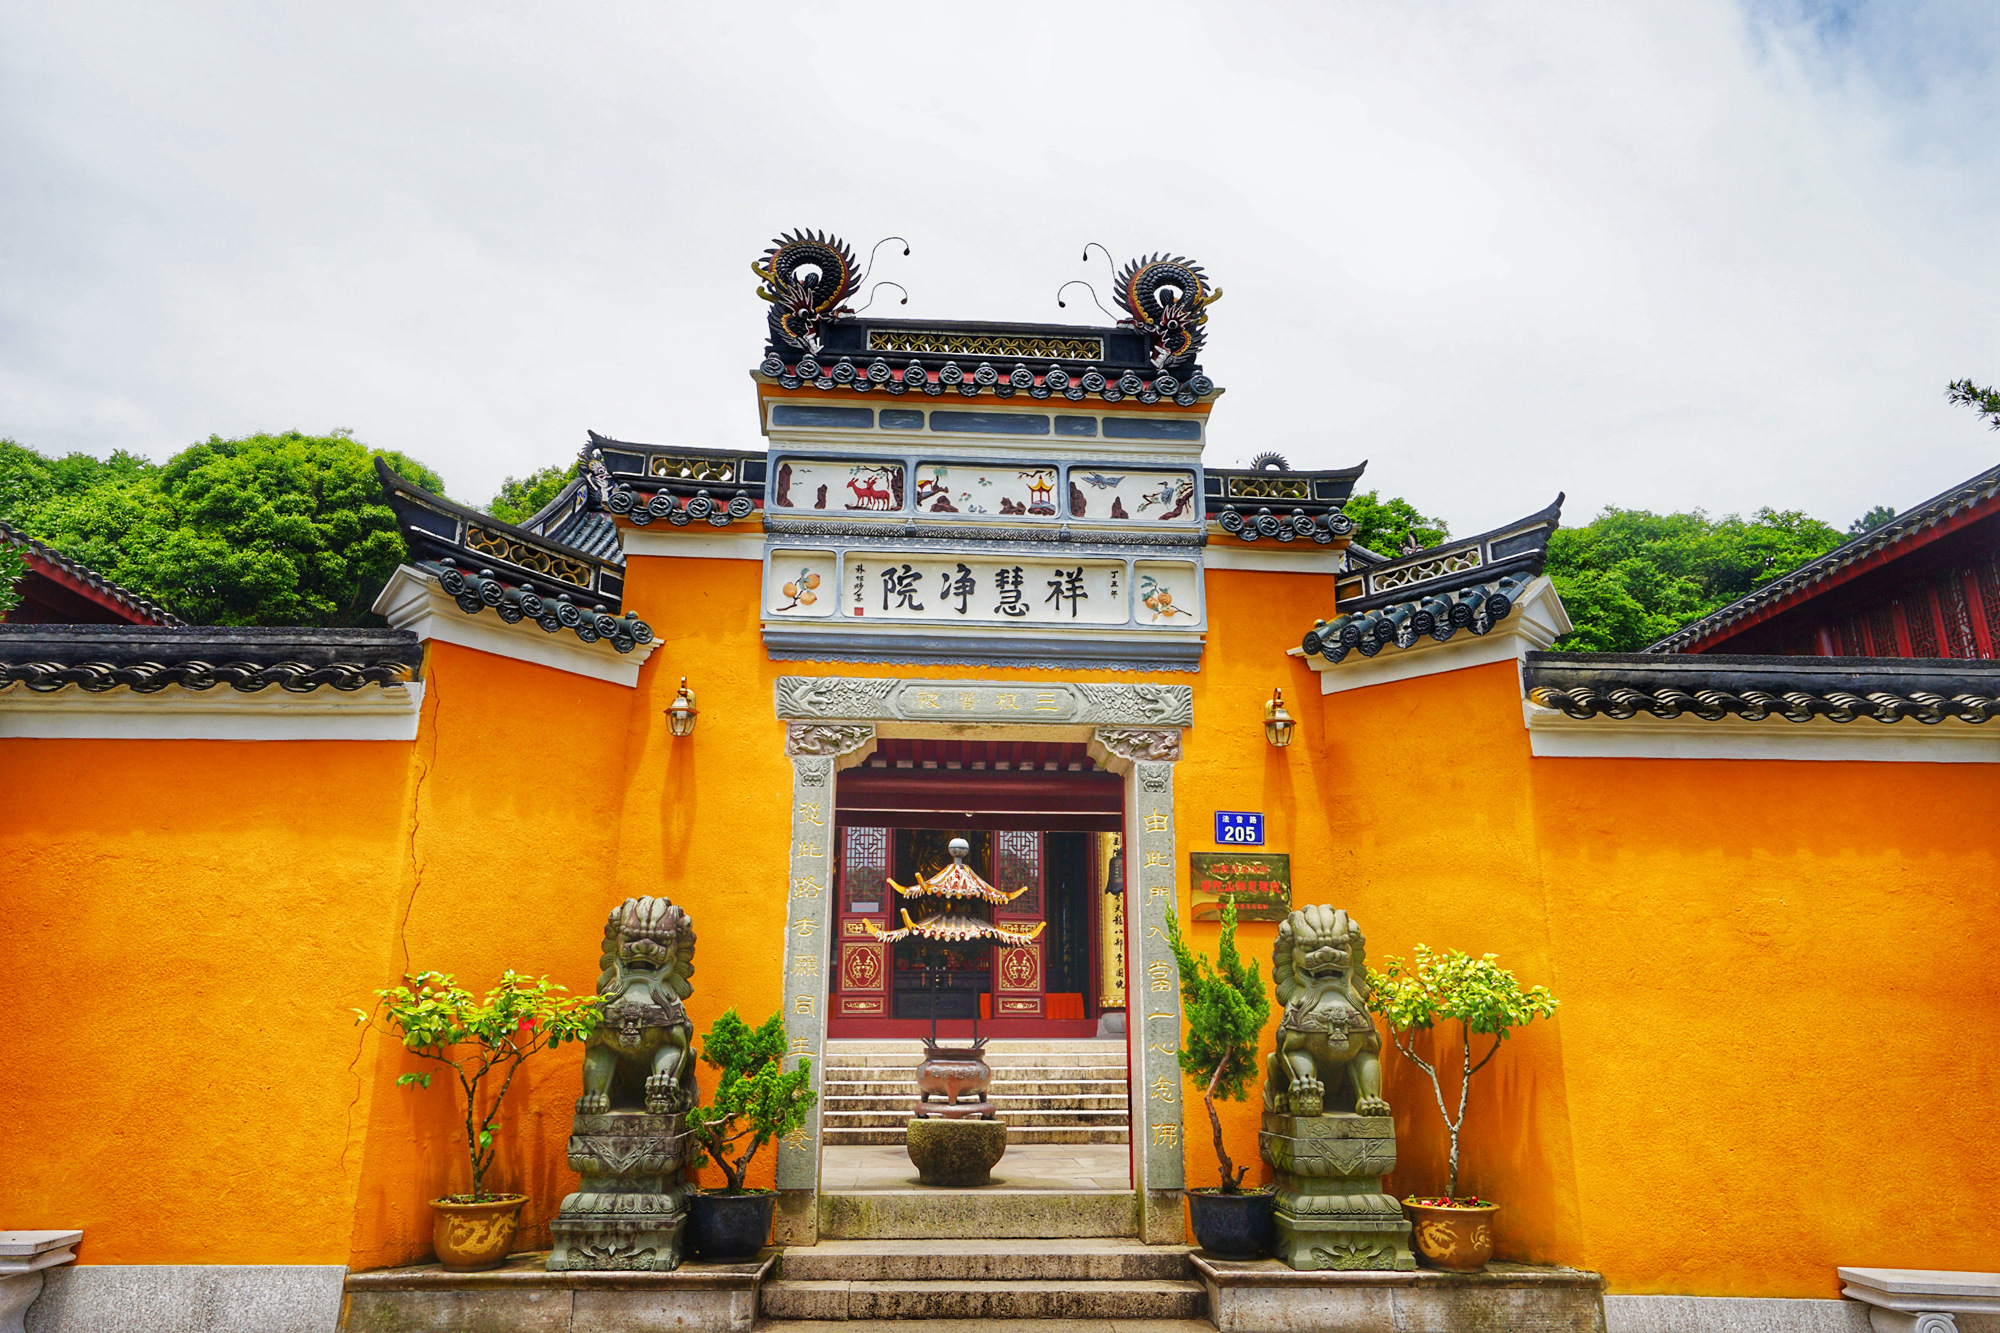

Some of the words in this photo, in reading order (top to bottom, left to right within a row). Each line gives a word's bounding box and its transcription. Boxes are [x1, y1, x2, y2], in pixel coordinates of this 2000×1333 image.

[1224, 825, 1256, 842] 205
[782, 801, 825, 1152] 從此路去願同生養
